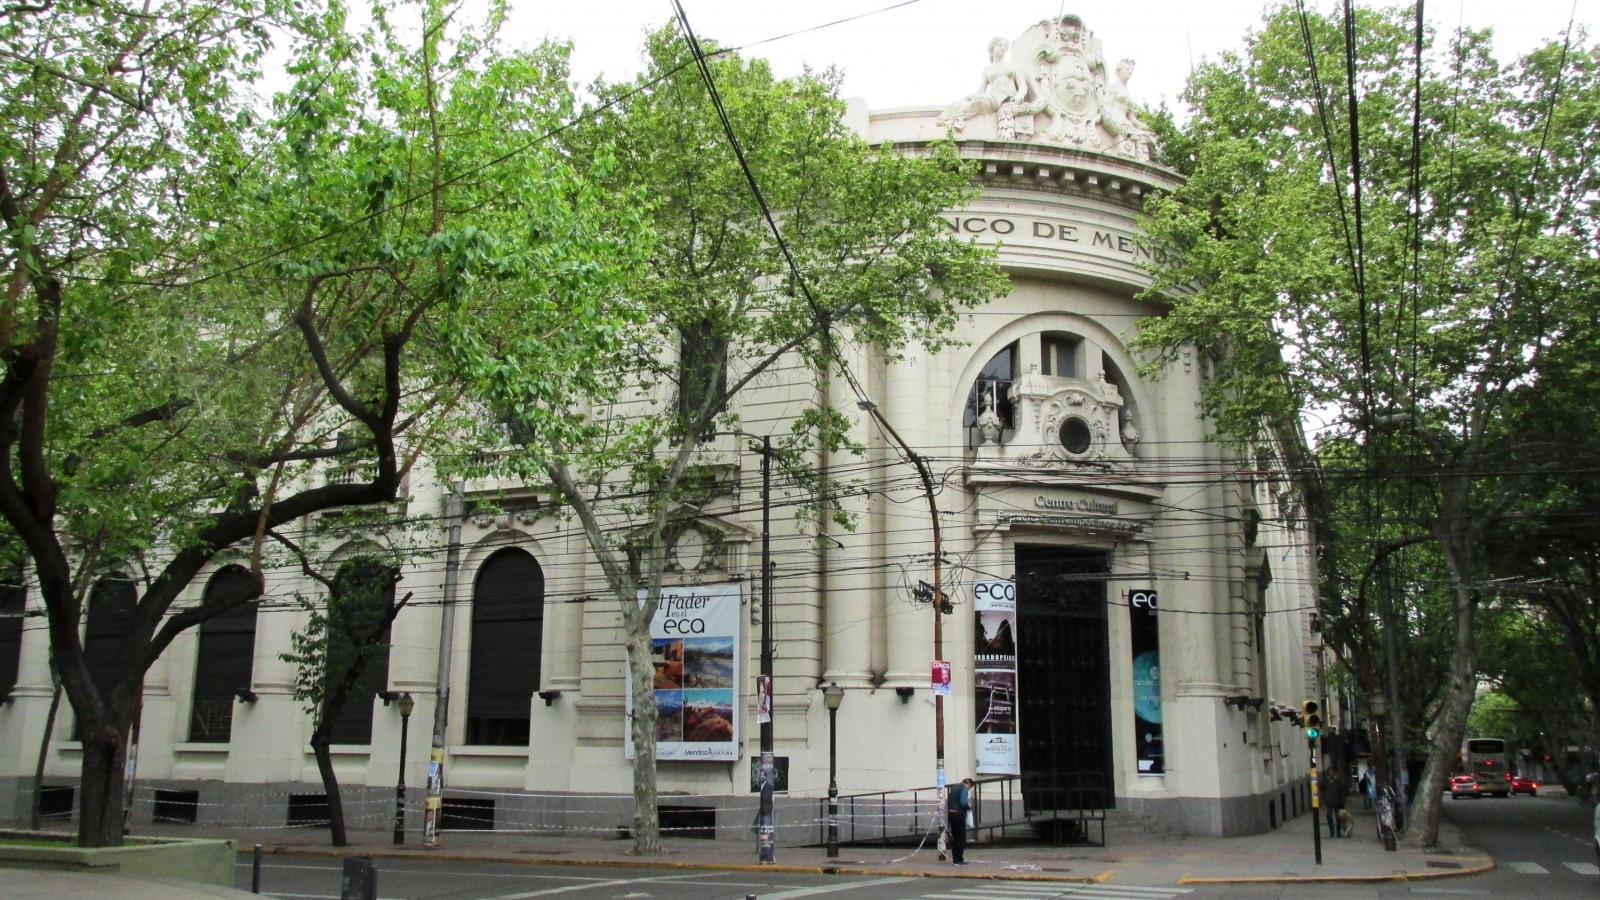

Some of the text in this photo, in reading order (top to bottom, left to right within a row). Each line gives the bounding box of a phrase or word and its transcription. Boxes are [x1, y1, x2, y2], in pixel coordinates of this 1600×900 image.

[1033, 221, 1079, 242] DE
[1035, 495, 1119, 514] Centro Cultural
[974, 583, 1015, 601] eca
[665, 592, 710, 617] Fader
[680, 608, 687, 617] el
[663, 617, 705, 634] eca
